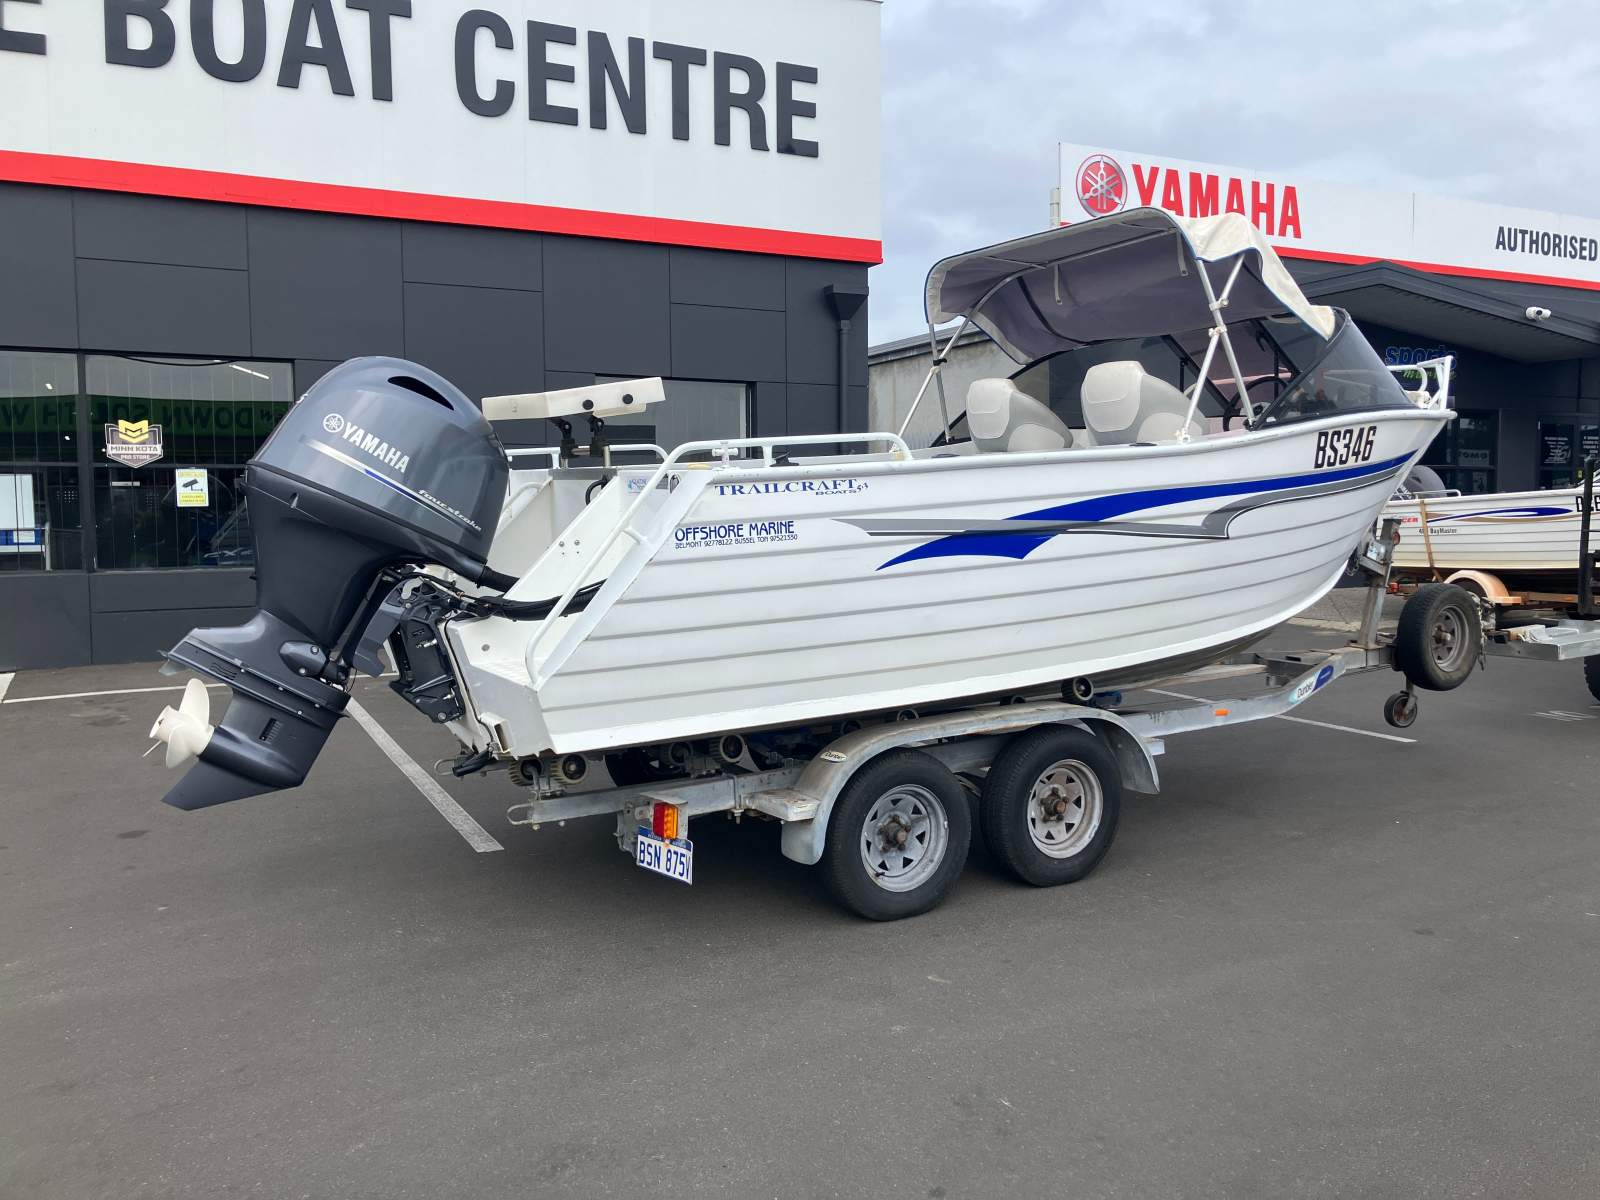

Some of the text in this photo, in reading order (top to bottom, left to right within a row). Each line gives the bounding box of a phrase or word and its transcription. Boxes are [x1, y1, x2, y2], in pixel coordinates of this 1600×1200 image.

[105, 0, 412, 101] BOAT
[454, 10, 819, 158] CENTRE
[1132, 164, 1301, 239] YAMAHA
[1495, 225, 1598, 262] AUTHORISED
[341, 421, 410, 474] YAMAHA
[1314, 425, 1377, 469] BS346
[714, 478, 857, 497] TRAILCRAFT
[674, 520, 795, 542] OFFSHORE MARINE
[639, 840, 662, 870] BSN
